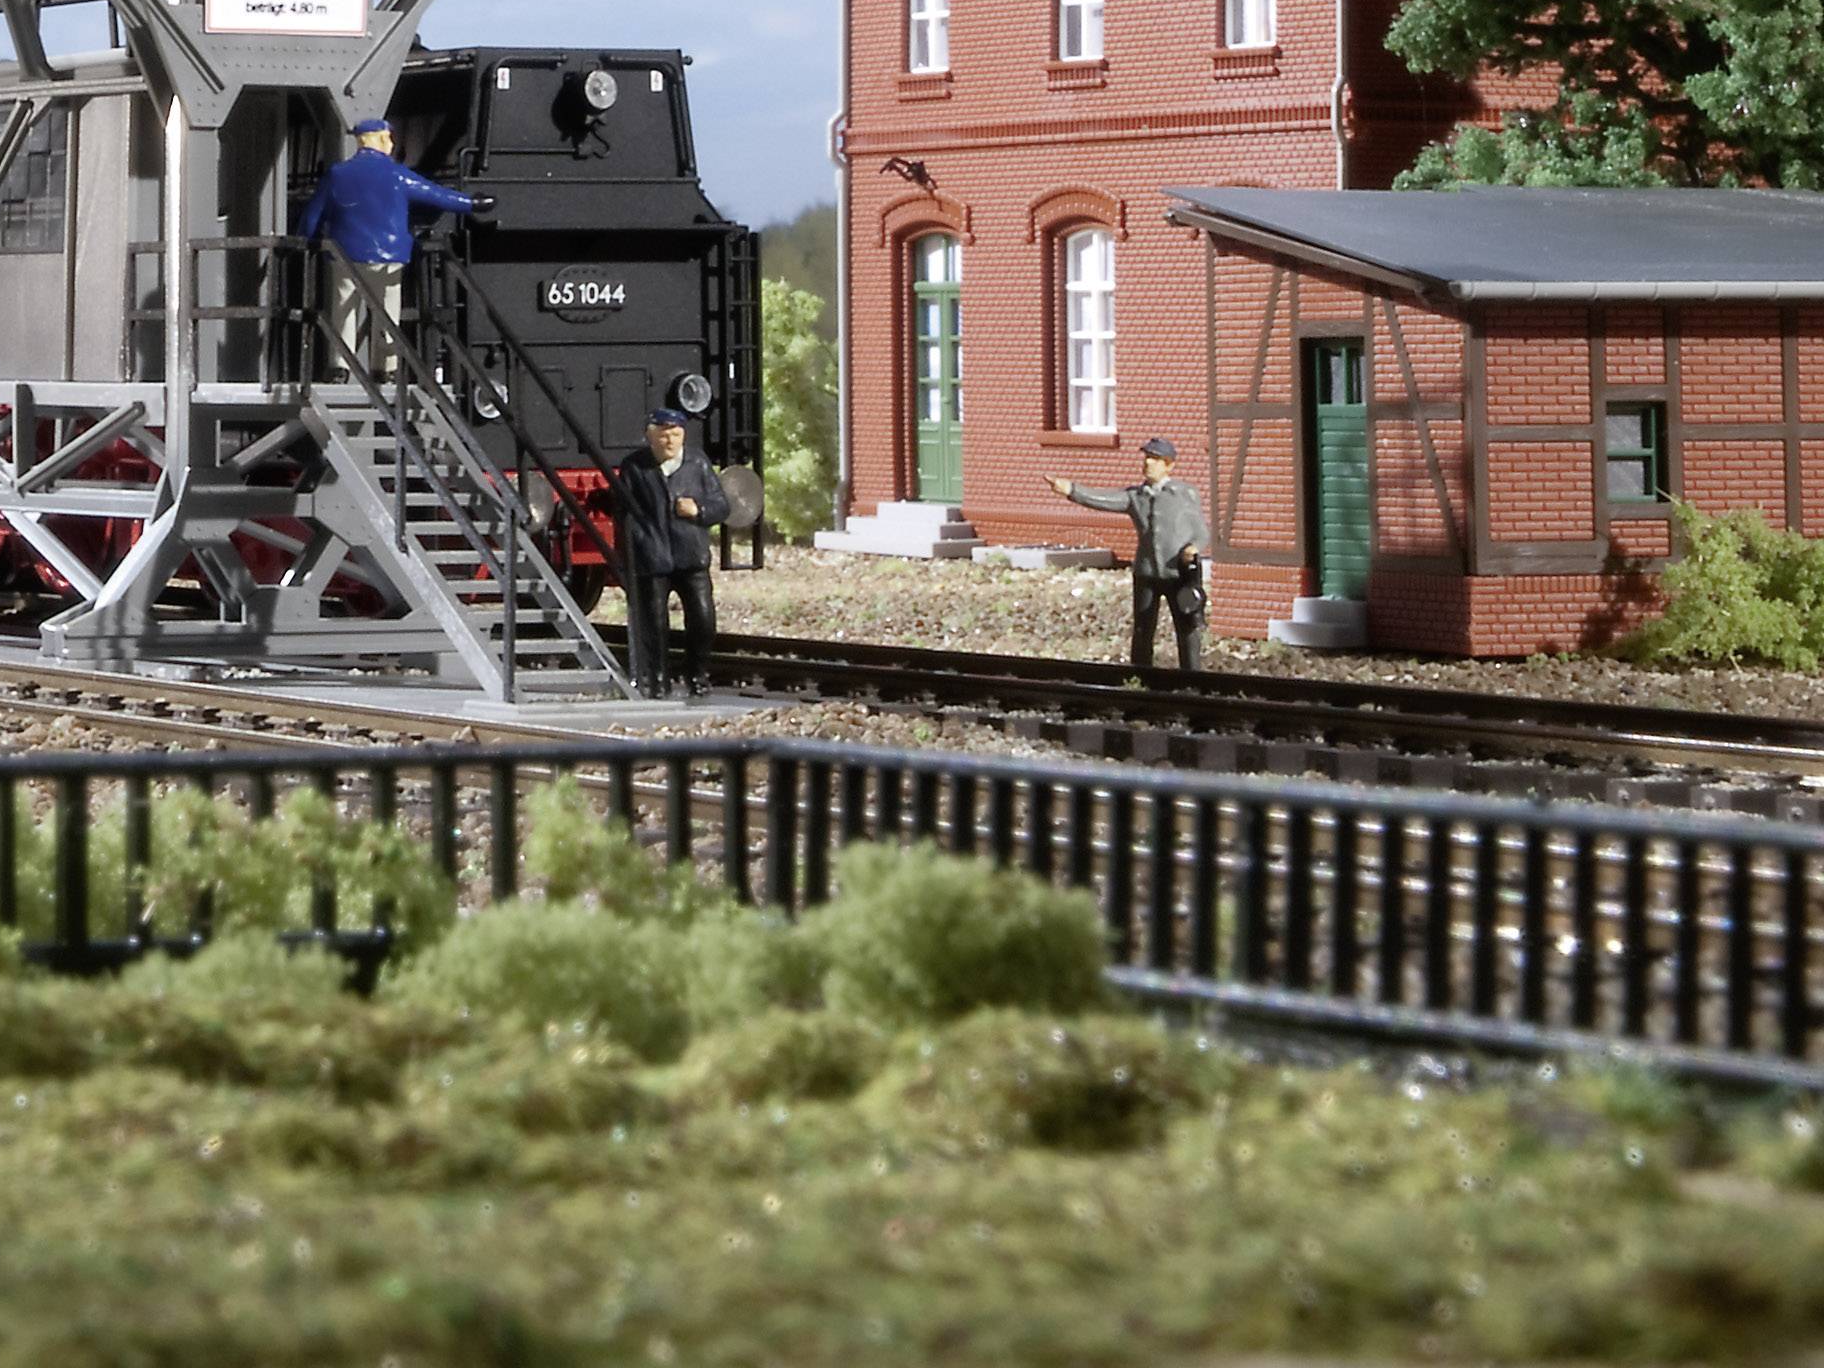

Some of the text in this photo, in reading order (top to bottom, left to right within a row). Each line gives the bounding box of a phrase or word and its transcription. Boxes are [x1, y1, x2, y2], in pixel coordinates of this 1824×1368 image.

[316, 5, 327, 14] m
[548, 282, 626, 305] 65 1044
